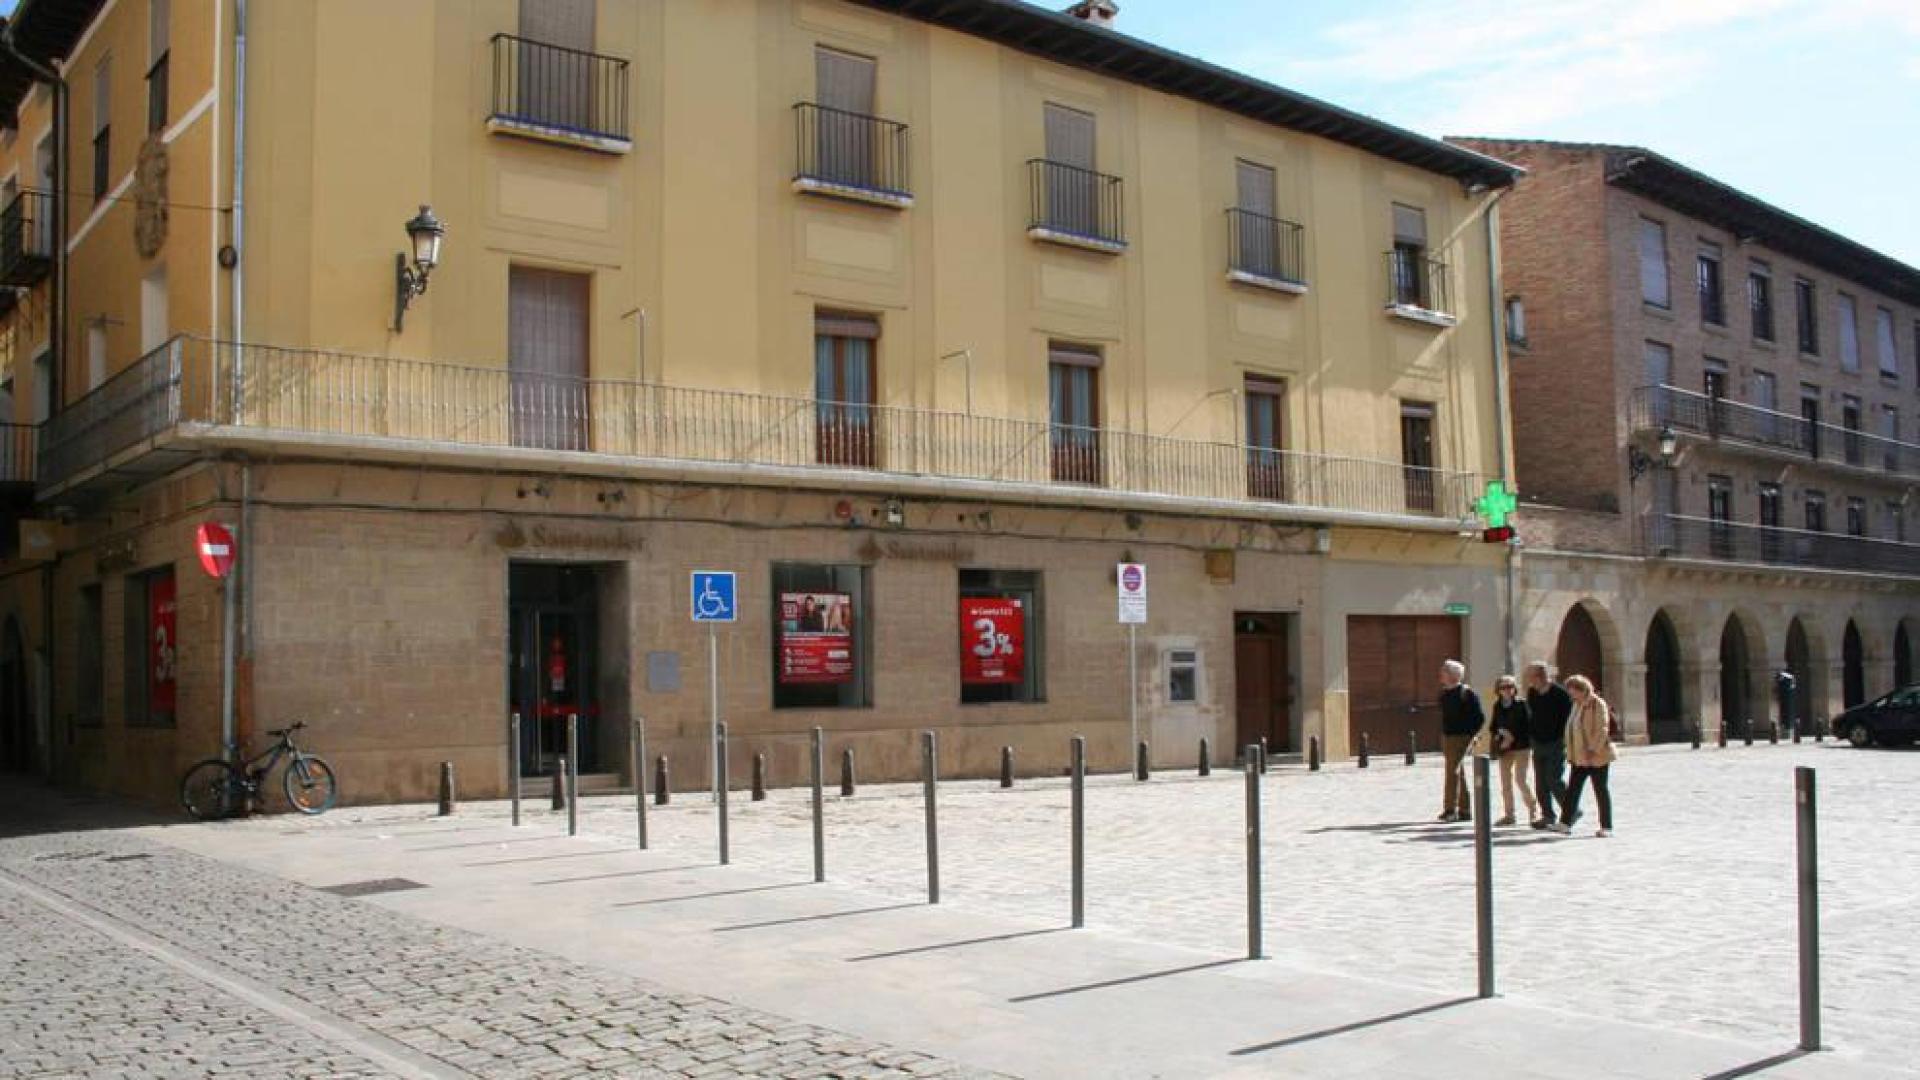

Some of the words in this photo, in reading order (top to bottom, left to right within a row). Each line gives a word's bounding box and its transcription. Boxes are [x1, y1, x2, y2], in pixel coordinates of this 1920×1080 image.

[532, 523, 647, 550] Santander
[887, 540, 974, 561] Santander
[973, 618, 1014, 656] 3%
